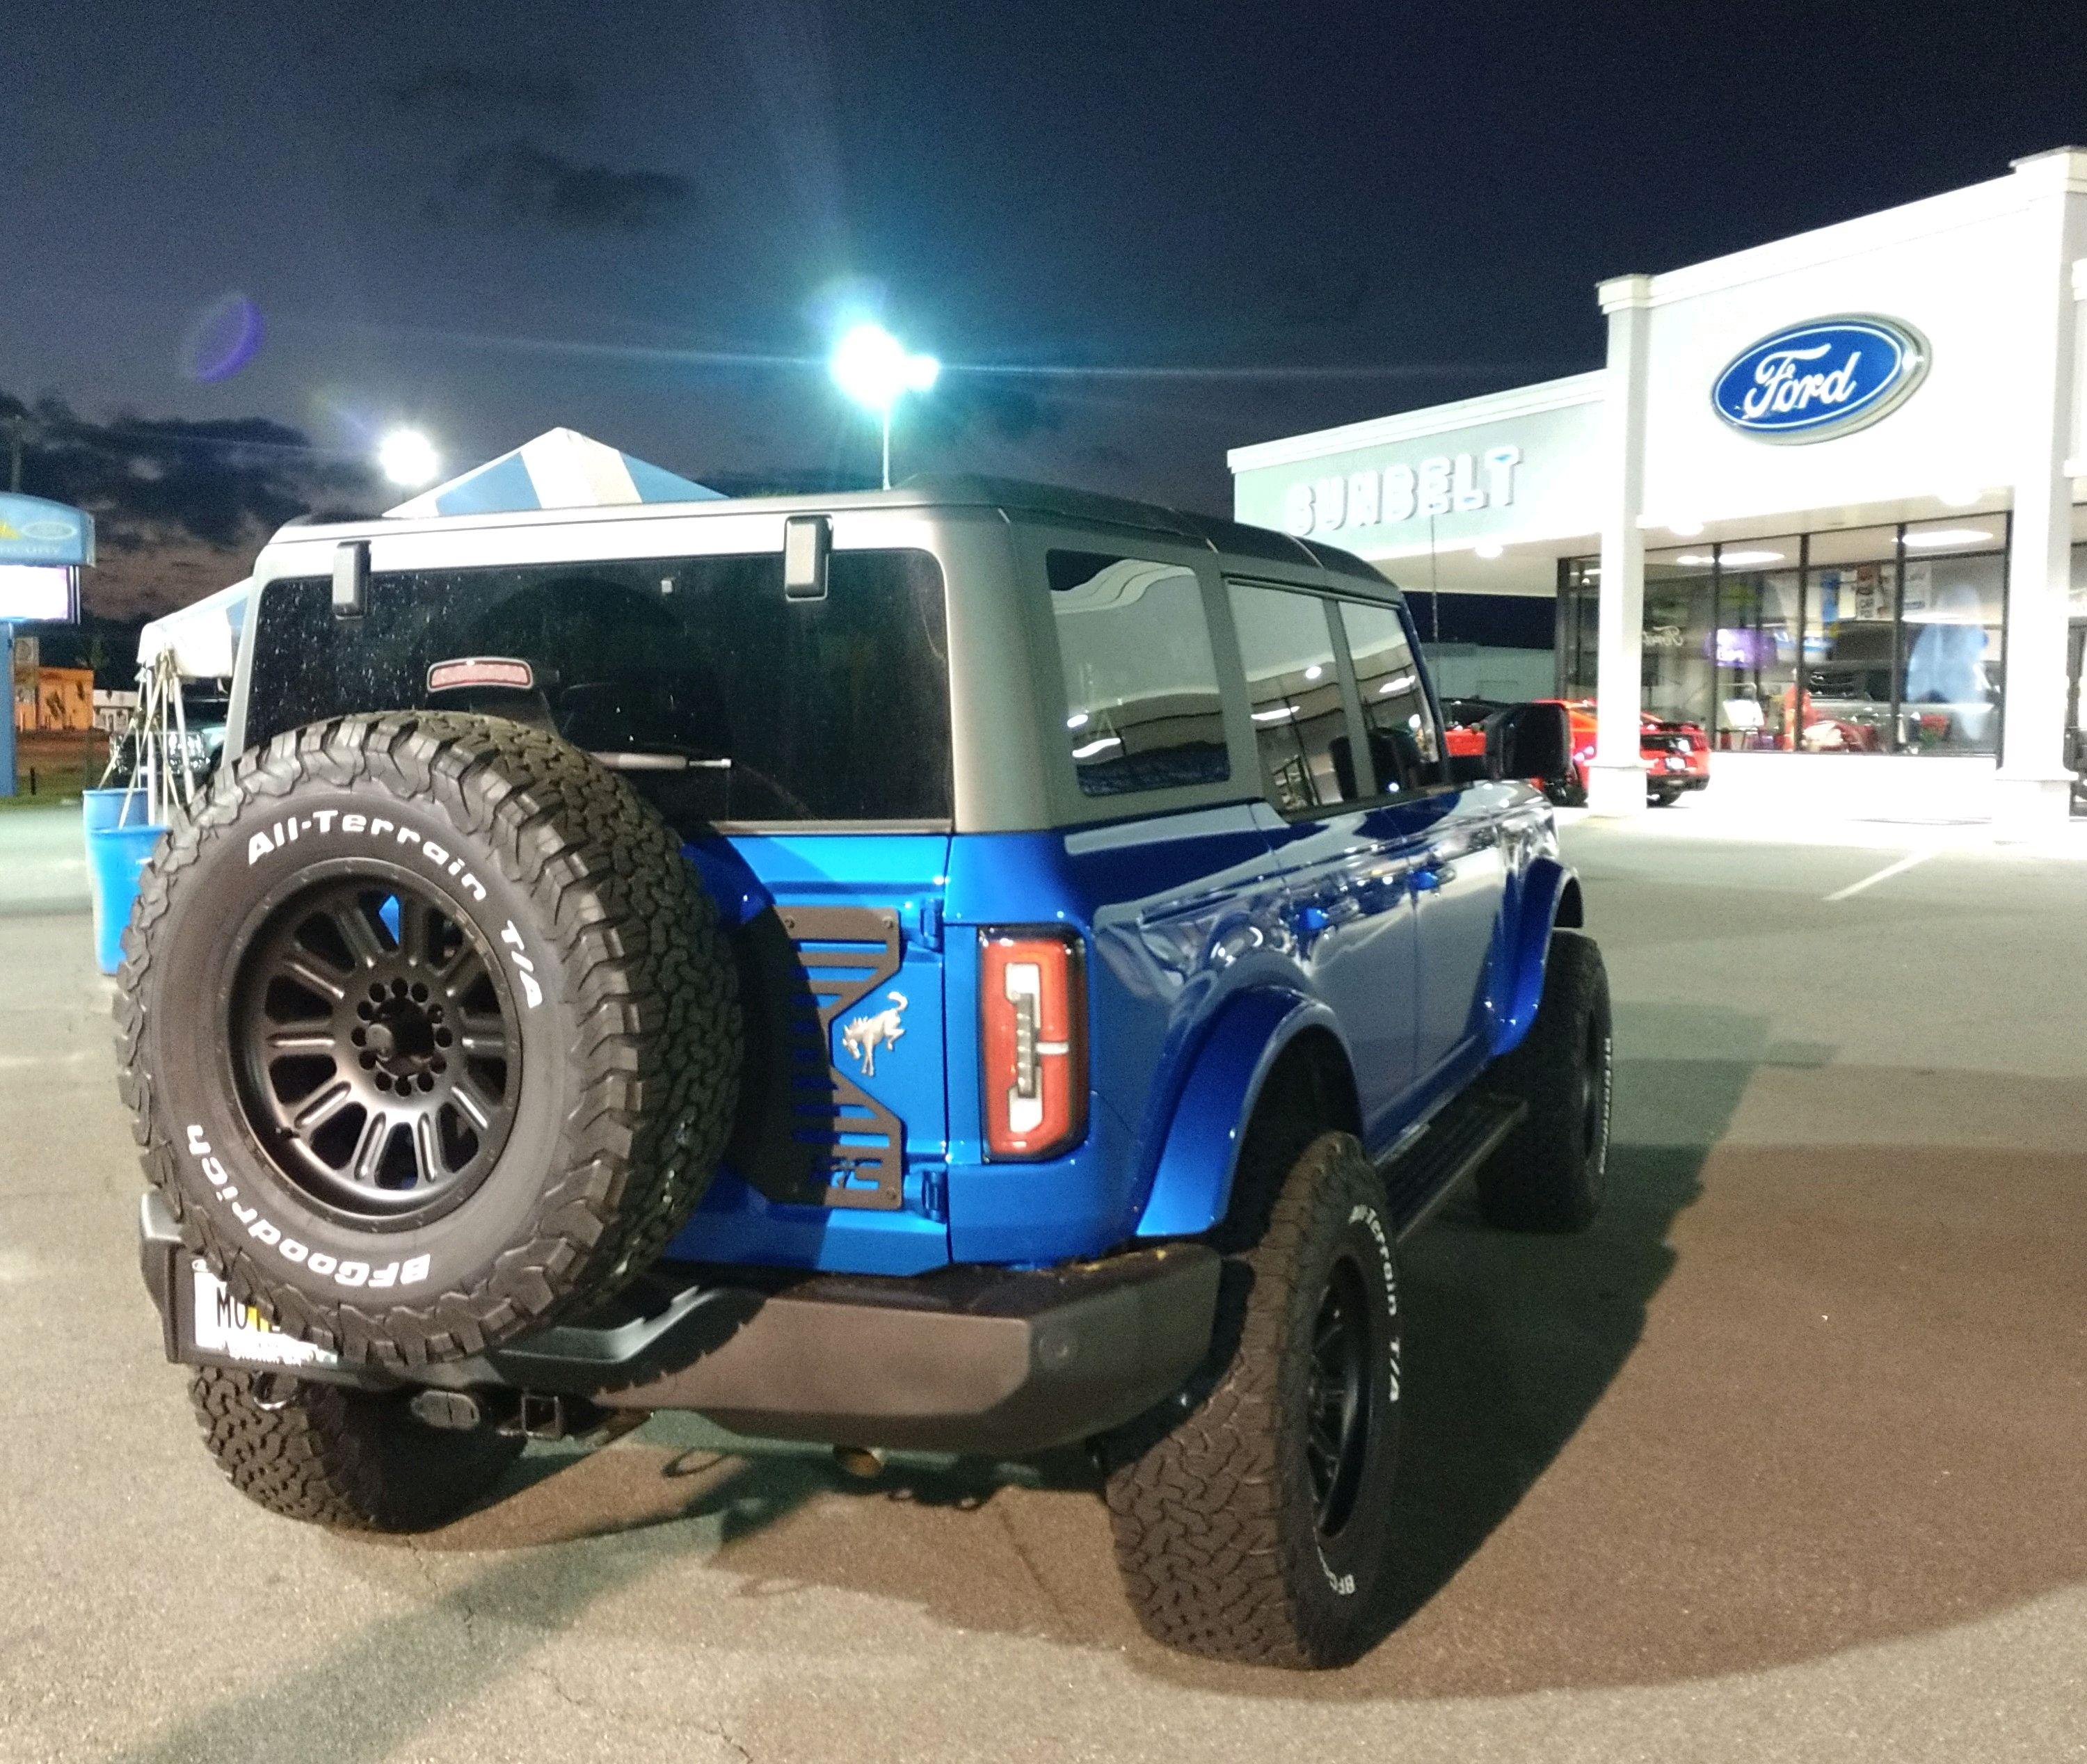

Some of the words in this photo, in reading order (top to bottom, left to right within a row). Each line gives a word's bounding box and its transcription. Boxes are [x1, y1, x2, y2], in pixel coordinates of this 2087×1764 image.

[1741, 343, 1862, 419] Ford
[1286, 444, 1523, 536] SUNBELT
[248, 810, 486, 901] All-Terrain
[501, 920, 543, 1008] T/A
[187, 1125, 431, 1288] BFGoodrich
